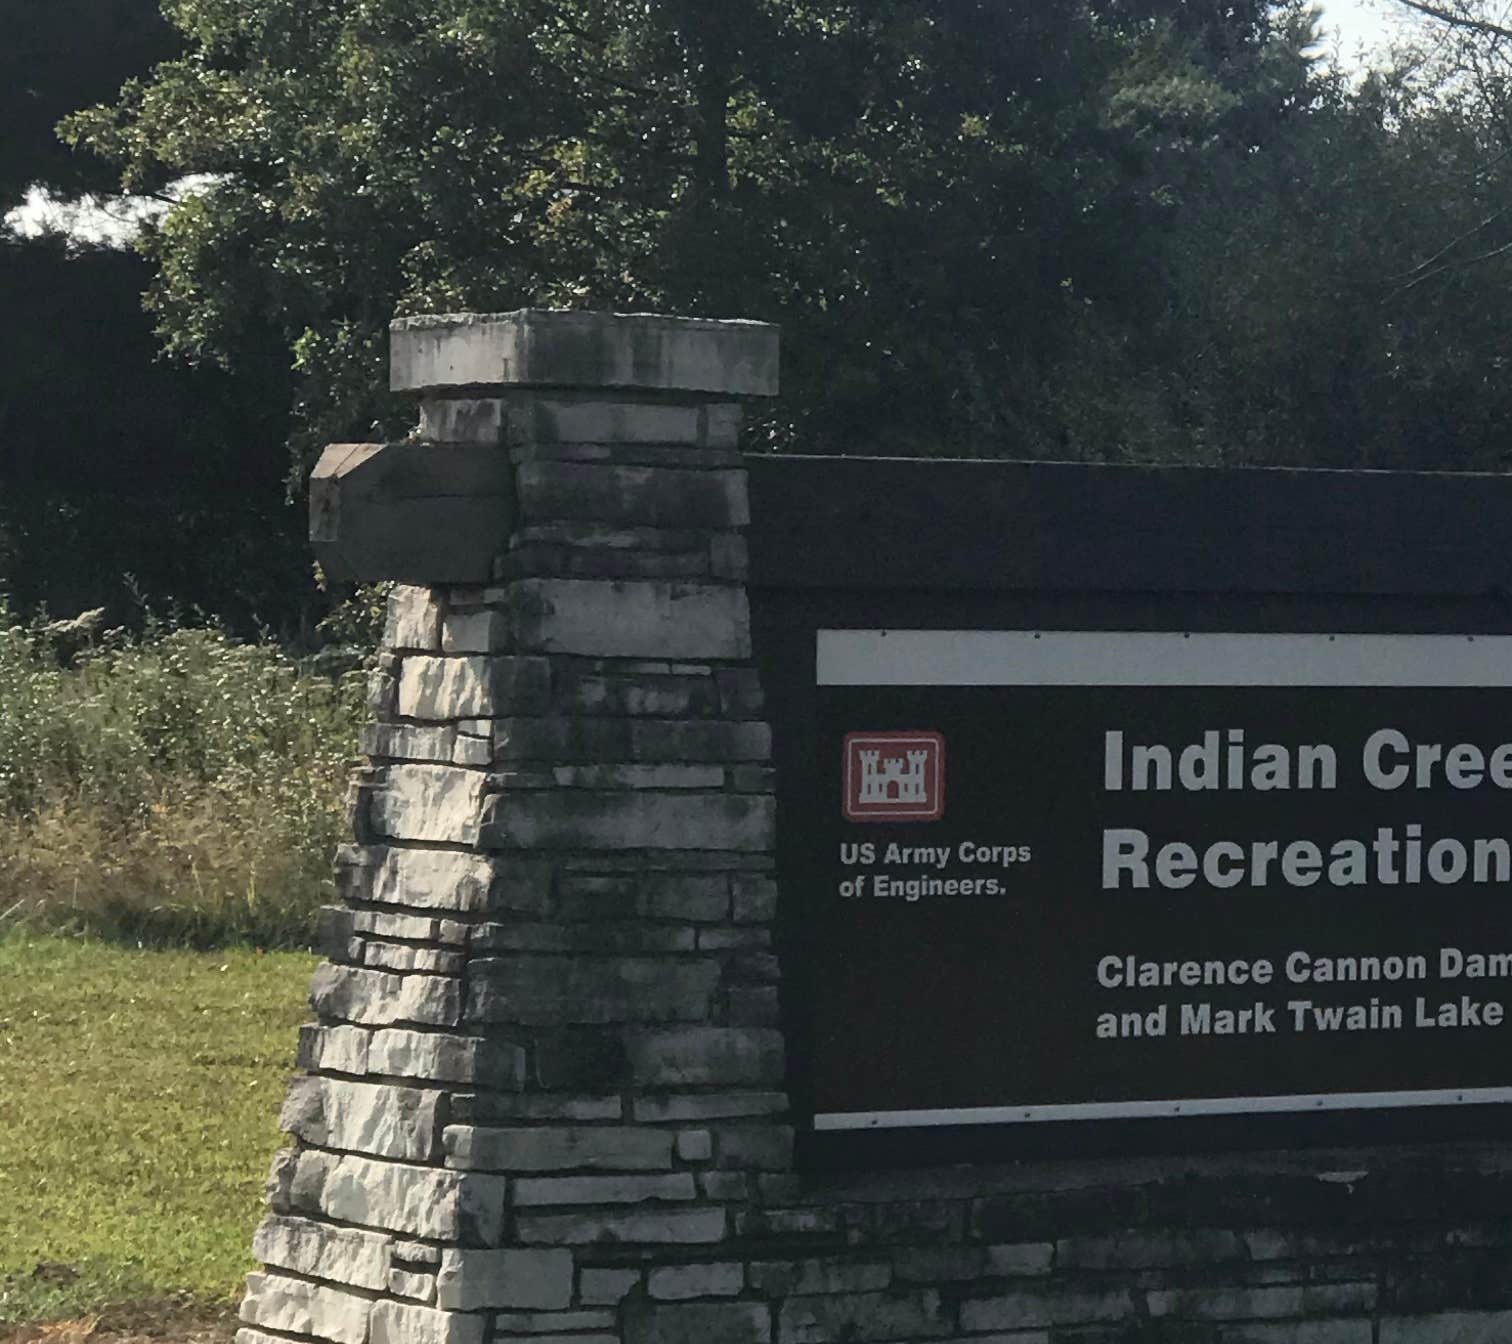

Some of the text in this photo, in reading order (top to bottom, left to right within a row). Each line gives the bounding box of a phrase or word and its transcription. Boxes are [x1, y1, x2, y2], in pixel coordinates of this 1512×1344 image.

[1105, 729, 1336, 790] Indian
[841, 842, 1031, 868] US Army Corps
[1103, 824, 1510, 888] Recreation
[840, 875, 1006, 901] of Engineers.
[1098, 956, 1273, 987] Clarence
[1286, 951, 1426, 982] Cannon
[1097, 996, 1503, 1038] and Mark Twain Lake
